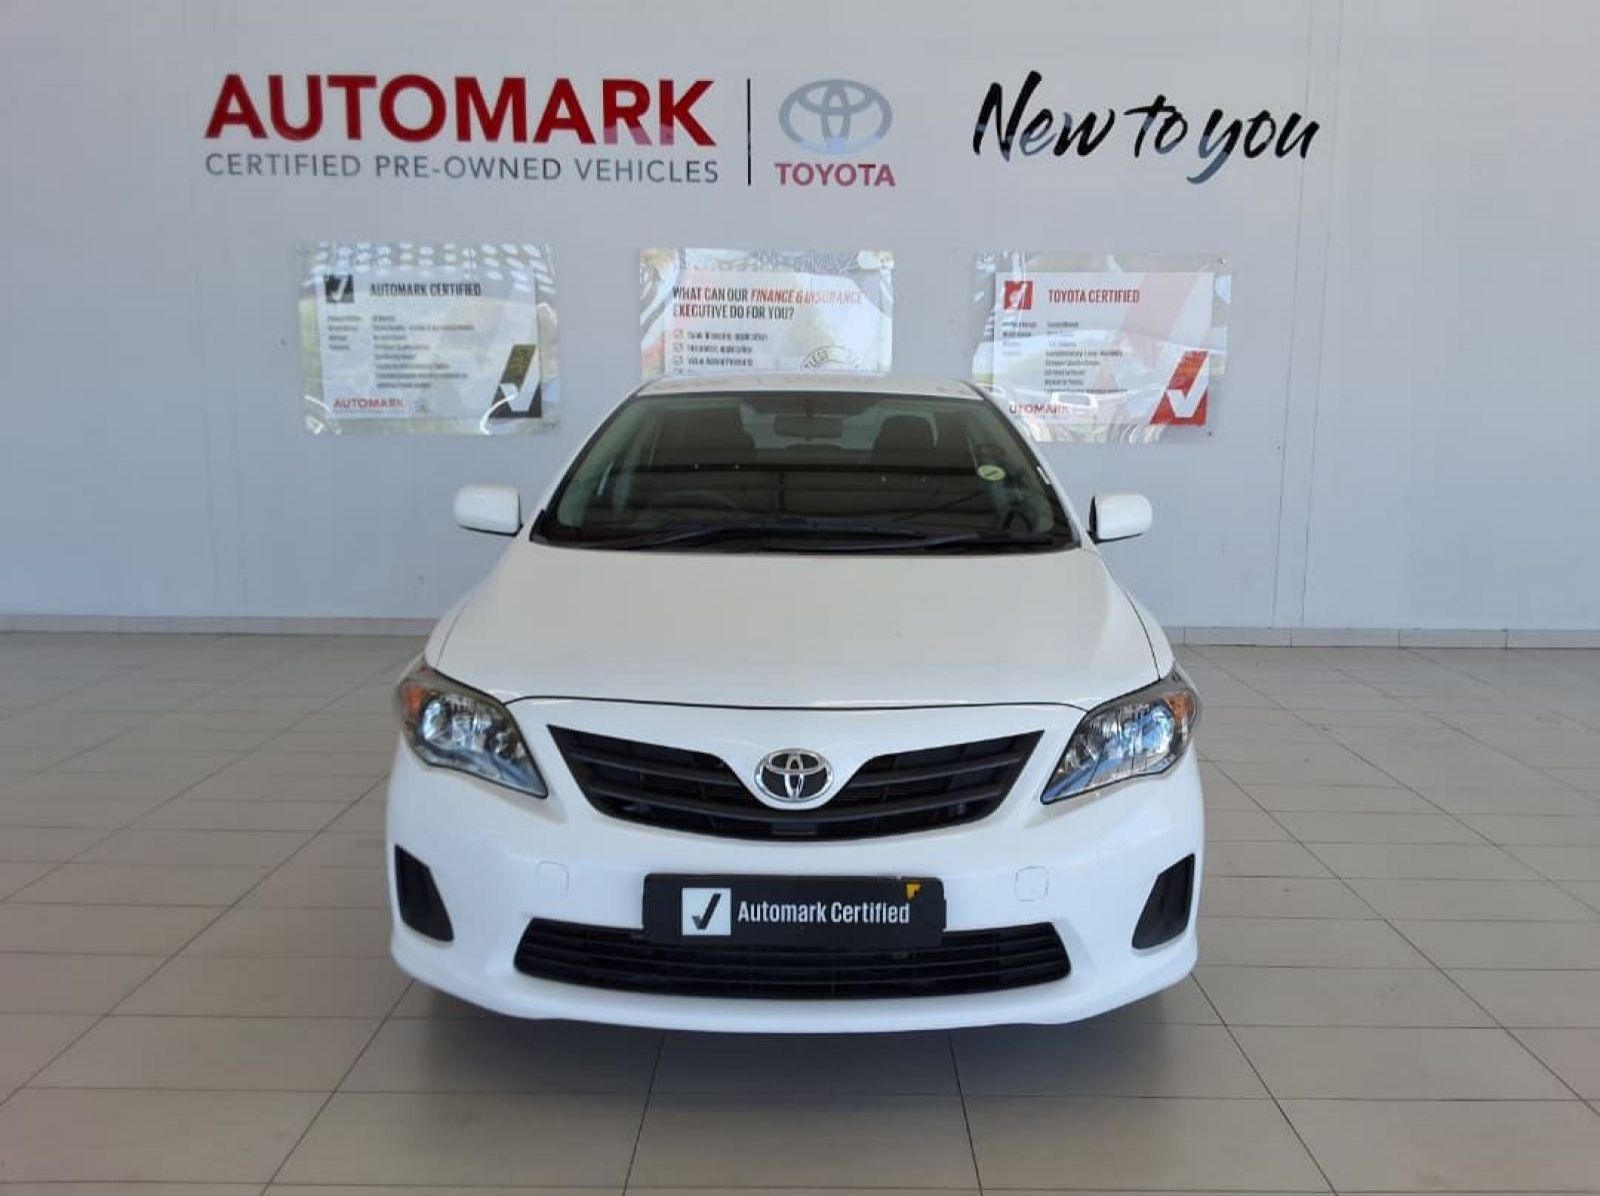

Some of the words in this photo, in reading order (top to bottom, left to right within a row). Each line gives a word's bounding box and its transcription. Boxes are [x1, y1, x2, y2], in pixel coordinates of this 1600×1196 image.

[204, 73, 716, 147] AUTOMARK
[973, 70, 1115, 161] New
[1123, 94, 1188, 158] to
[1187, 108, 1320, 184] you
[206, 153, 361, 177] CERTIFIED
[376, 155, 561, 180] PRE-OWNED
[574, 158, 718, 183] VEHICLES
[774, 162, 895, 187] TOYOTA
[371, 283, 428, 297] AUTOMARK
[430, 283, 481, 297] CERTIFIED
[673, 285, 701, 301] WHAT
[705, 287, 725, 302] CAN
[727, 287, 748, 302] OUR
[750, 288, 794, 303] FINANCE
[804, 290, 862, 305] INSURANCE
[1048, 289, 1087, 304] TOYOTA
[1088, 289, 1140, 304] CERTIFIED
[673, 303, 727, 318] EXECUTIVE
[729, 304, 745, 319] DO
[746, 304, 765, 319] FOR
[768, 305, 794, 319] YOU?
[738, 900, 826, 923] Automark
[831, 901, 911, 924] Certified
